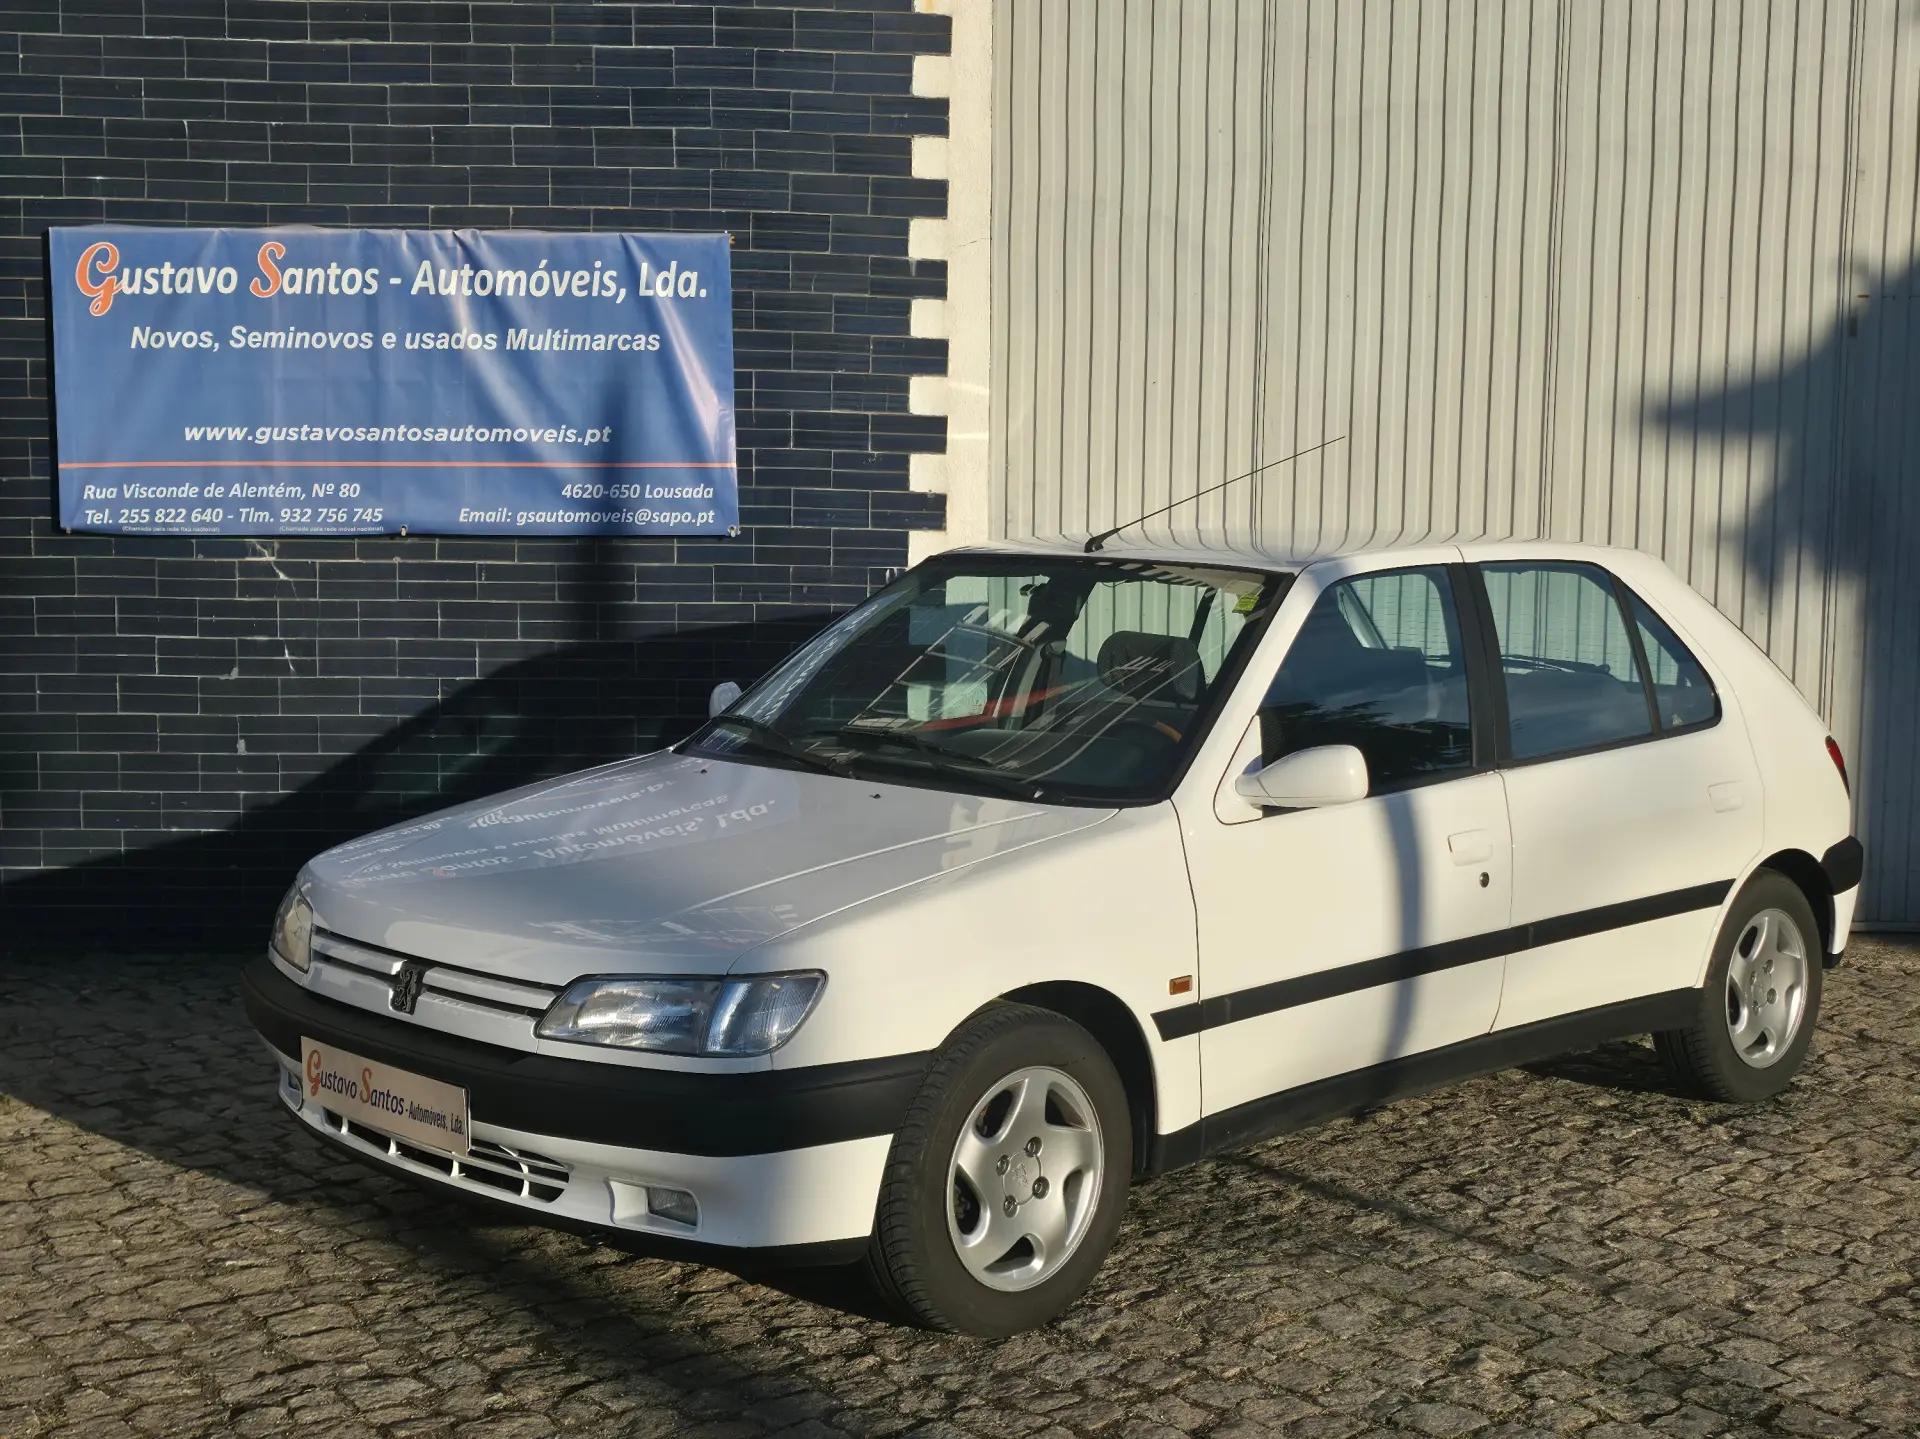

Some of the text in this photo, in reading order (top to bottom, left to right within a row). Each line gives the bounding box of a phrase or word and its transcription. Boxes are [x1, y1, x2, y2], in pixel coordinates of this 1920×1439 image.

[75, 241, 707, 316] Gustavo Santos - Automóveis, Lda.
[130, 325, 661, 352] Novos, Seminovos e usados Multimarcas
[184, 424, 612, 445] www.gustavosantosautomoveis.pt
[83, 484, 117, 499] Rua
[123, 482, 199, 499] Visconde
[203, 482, 225, 499] de
[229, 482, 306, 501] Alentém,
[339, 483, 360, 498] 80
[561, 483, 714, 499] 4620-650 Lousada
[85, 509, 113, 524] Tel.
[118, 509, 150, 524] 255
[154, 508, 186, 523] 822
[190, 508, 222, 523] 640
[239, 507, 274, 523] Tlm.
[280, 508, 312, 523] 932
[317, 508, 348, 523] 756
[352, 508, 383, 522] 745
[459, 508, 715, 526] Email: gsautomoveis@sapo.pt
[306, 1049, 358, 1099] Gustavo
[360, 1067, 404, 1116] Santos
[451, 1113, 465, 1135] Lda.
